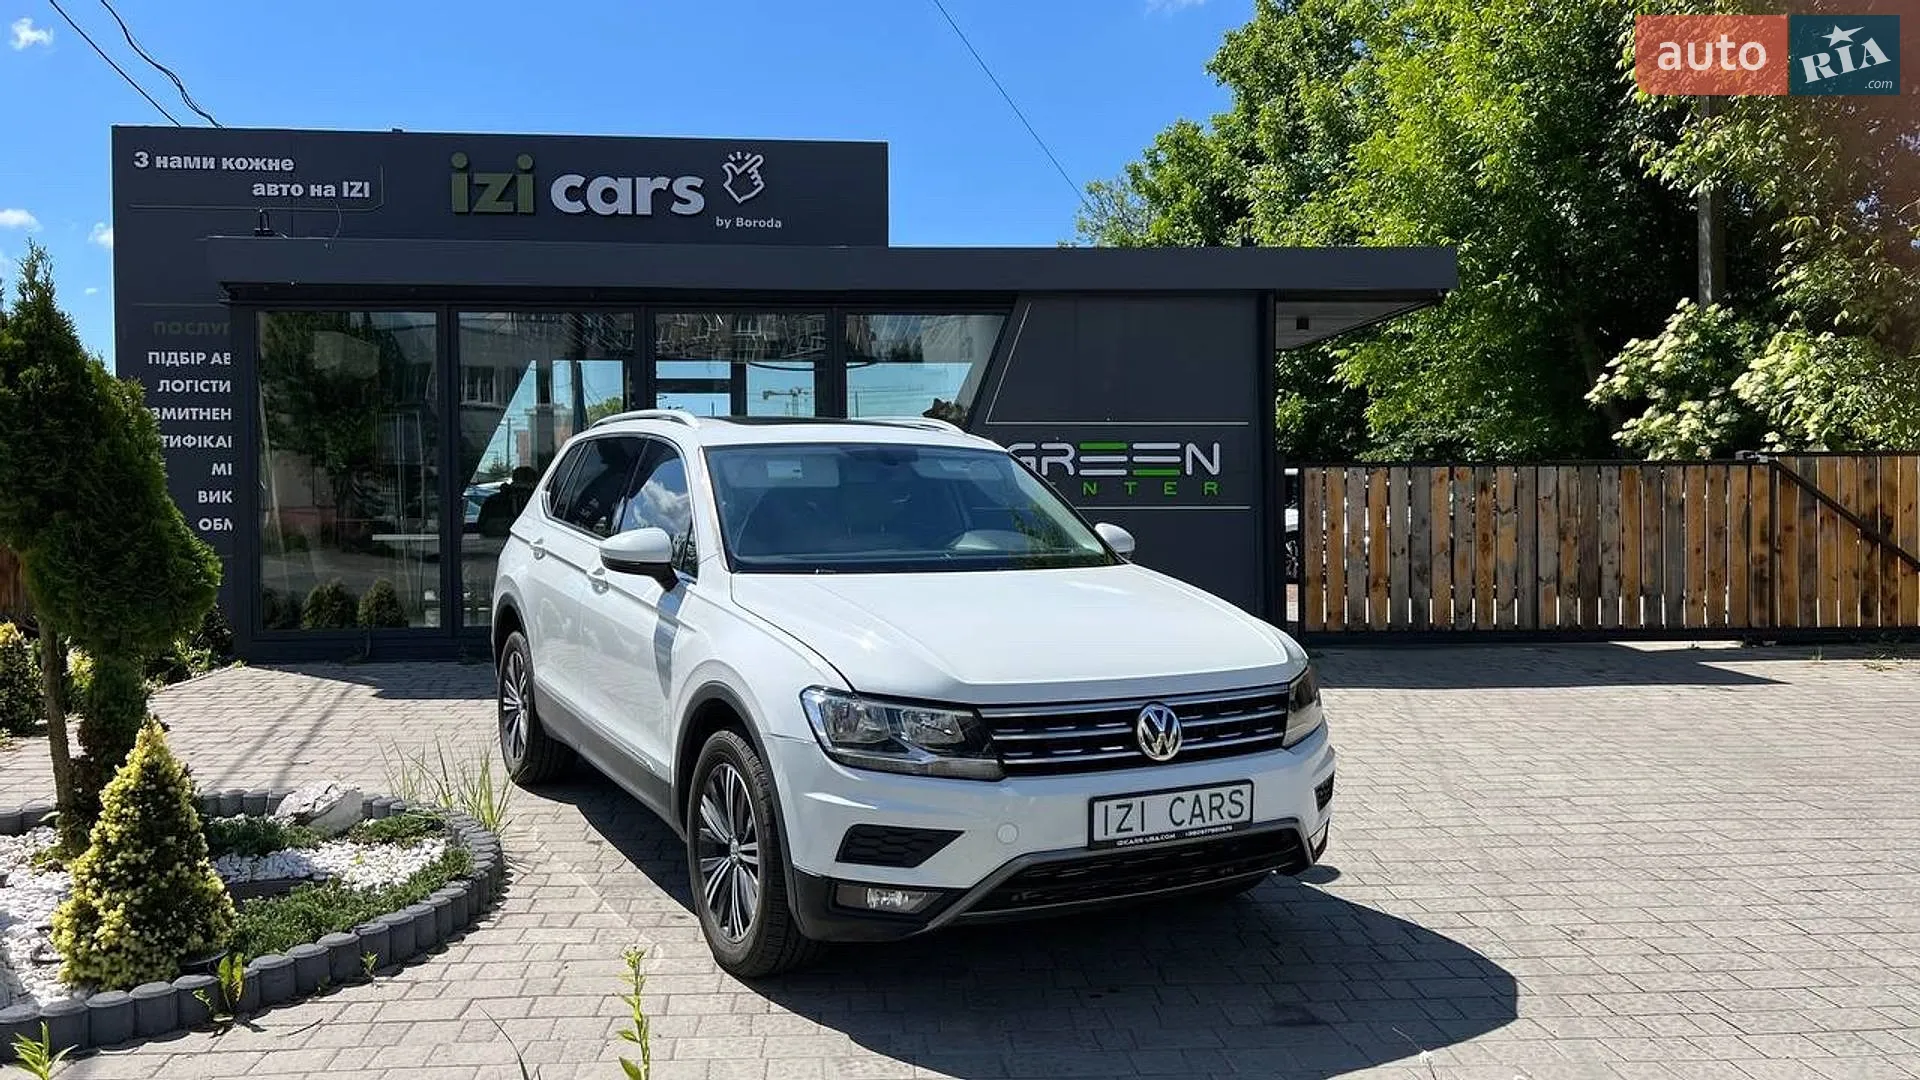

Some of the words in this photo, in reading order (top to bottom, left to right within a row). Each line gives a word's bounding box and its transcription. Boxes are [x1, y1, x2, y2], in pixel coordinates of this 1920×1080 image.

[155, 155, 215, 170] нами
[221, 157, 294, 171] кожне
[252, 182, 304, 197] авто
[310, 183, 336, 197] на
[342, 181, 370, 198] IZI
[450, 152, 534, 214] izi
[550, 174, 706, 215] cars
[715, 216, 732, 229] by
[736, 217, 782, 229] Boroda
[148, 351, 206, 367] ПІДБІР
[143, 407, 232, 421] ЗМИТНЕН
[1007, 442, 1220, 476] GREEN
[1050, 481, 1221, 496] NTER
[1103, 800, 1145, 836] IZI
[1169, 789, 1245, 827] CARS
